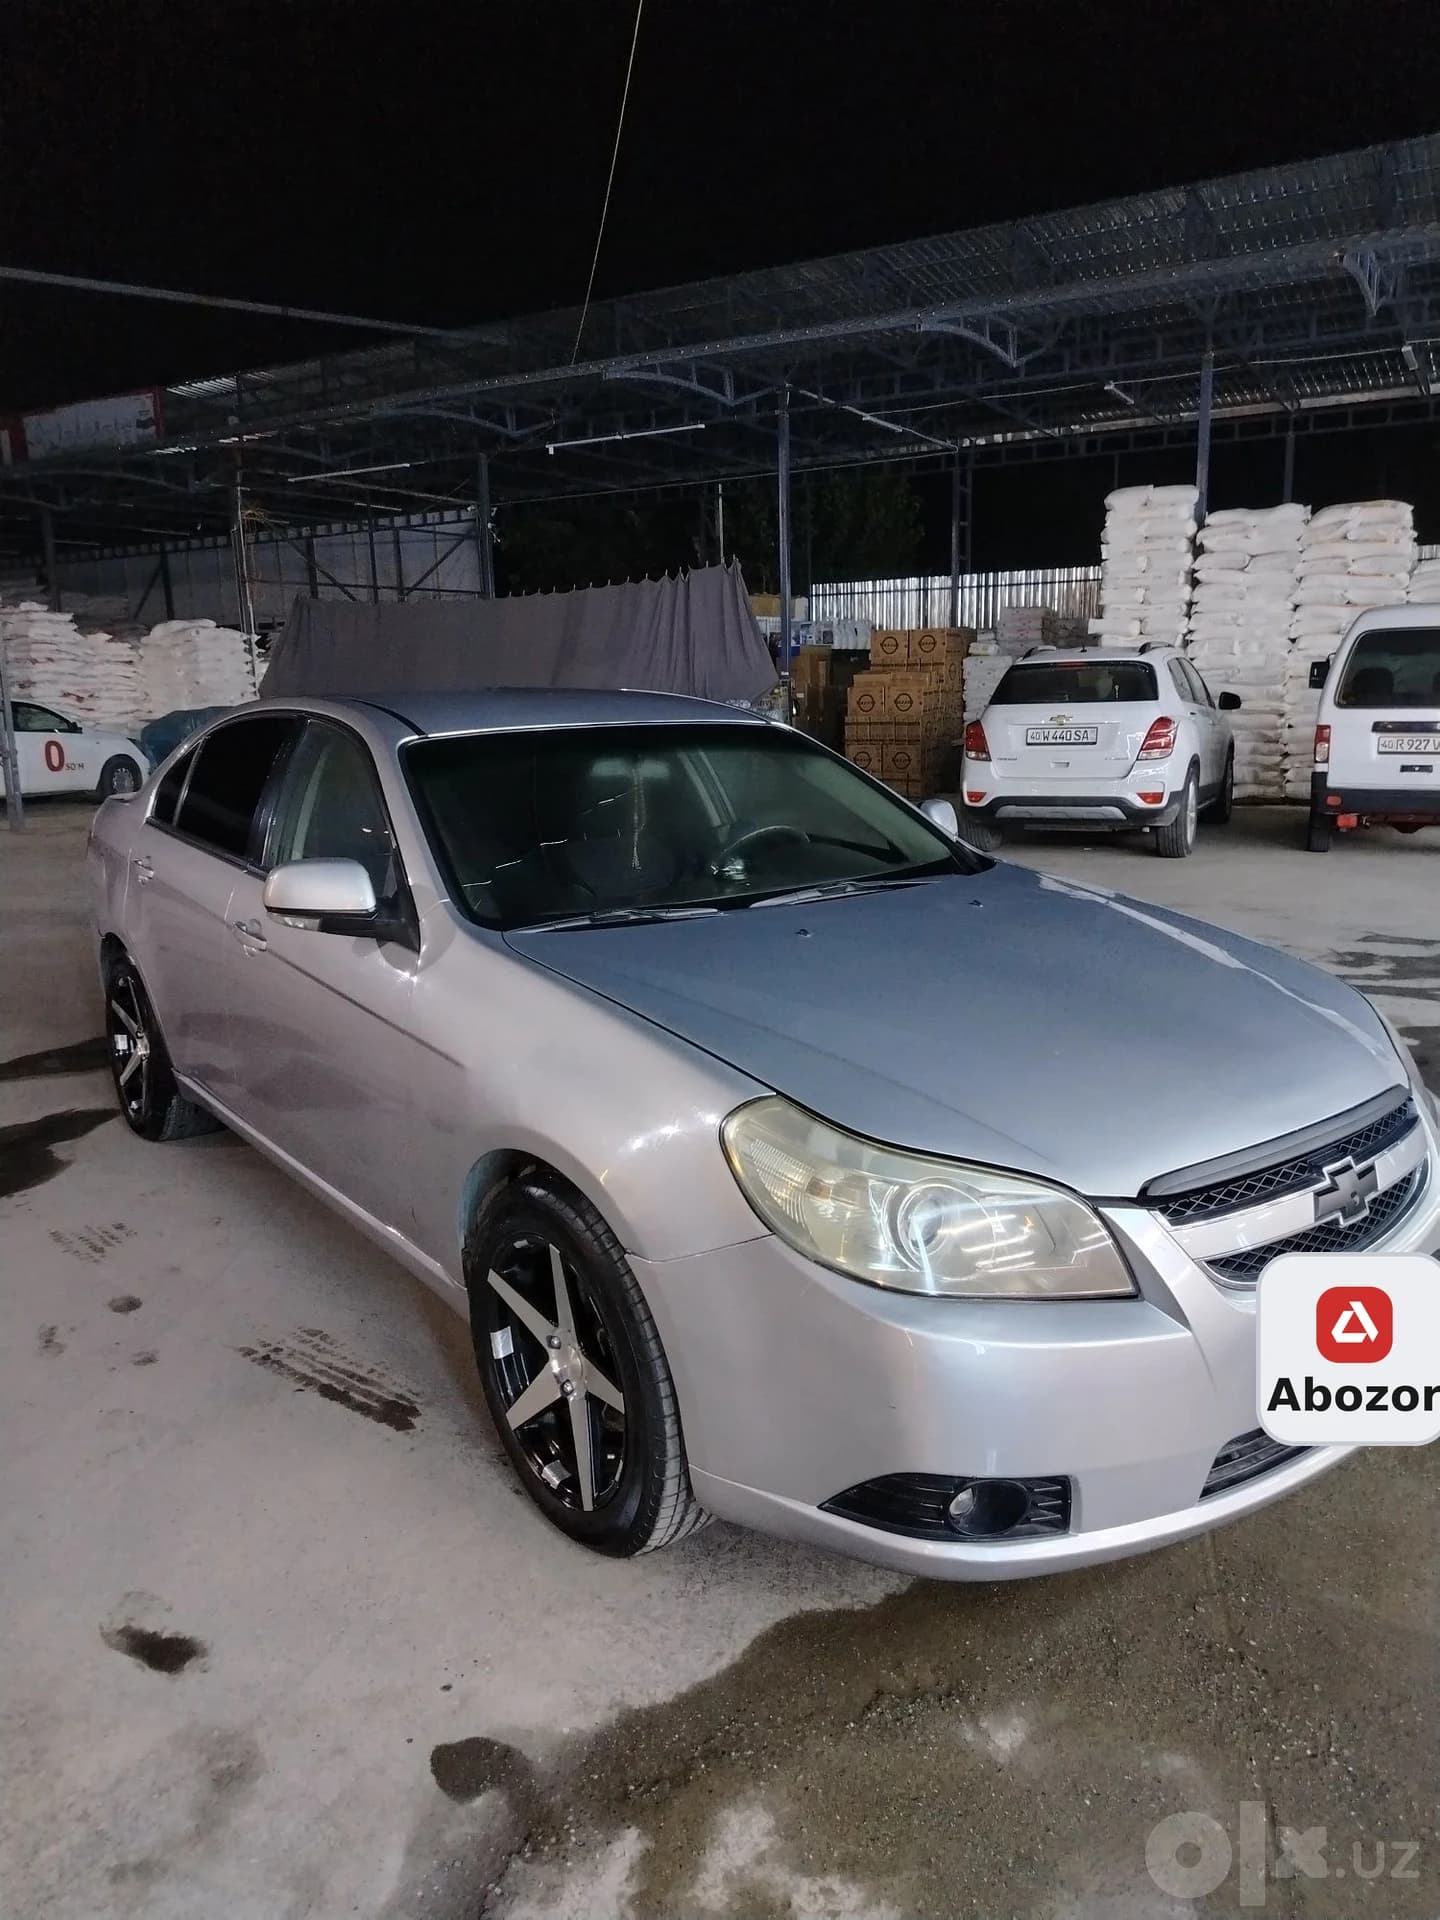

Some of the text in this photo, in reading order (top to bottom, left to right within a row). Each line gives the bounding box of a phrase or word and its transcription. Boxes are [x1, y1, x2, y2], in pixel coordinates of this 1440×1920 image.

[1030, 730, 1089, 741] 40 W 440 SA
[1380, 740, 1394, 750] 40
[1396, 739, 1404, 750] R
[1407, 739, 1430, 750] 927
